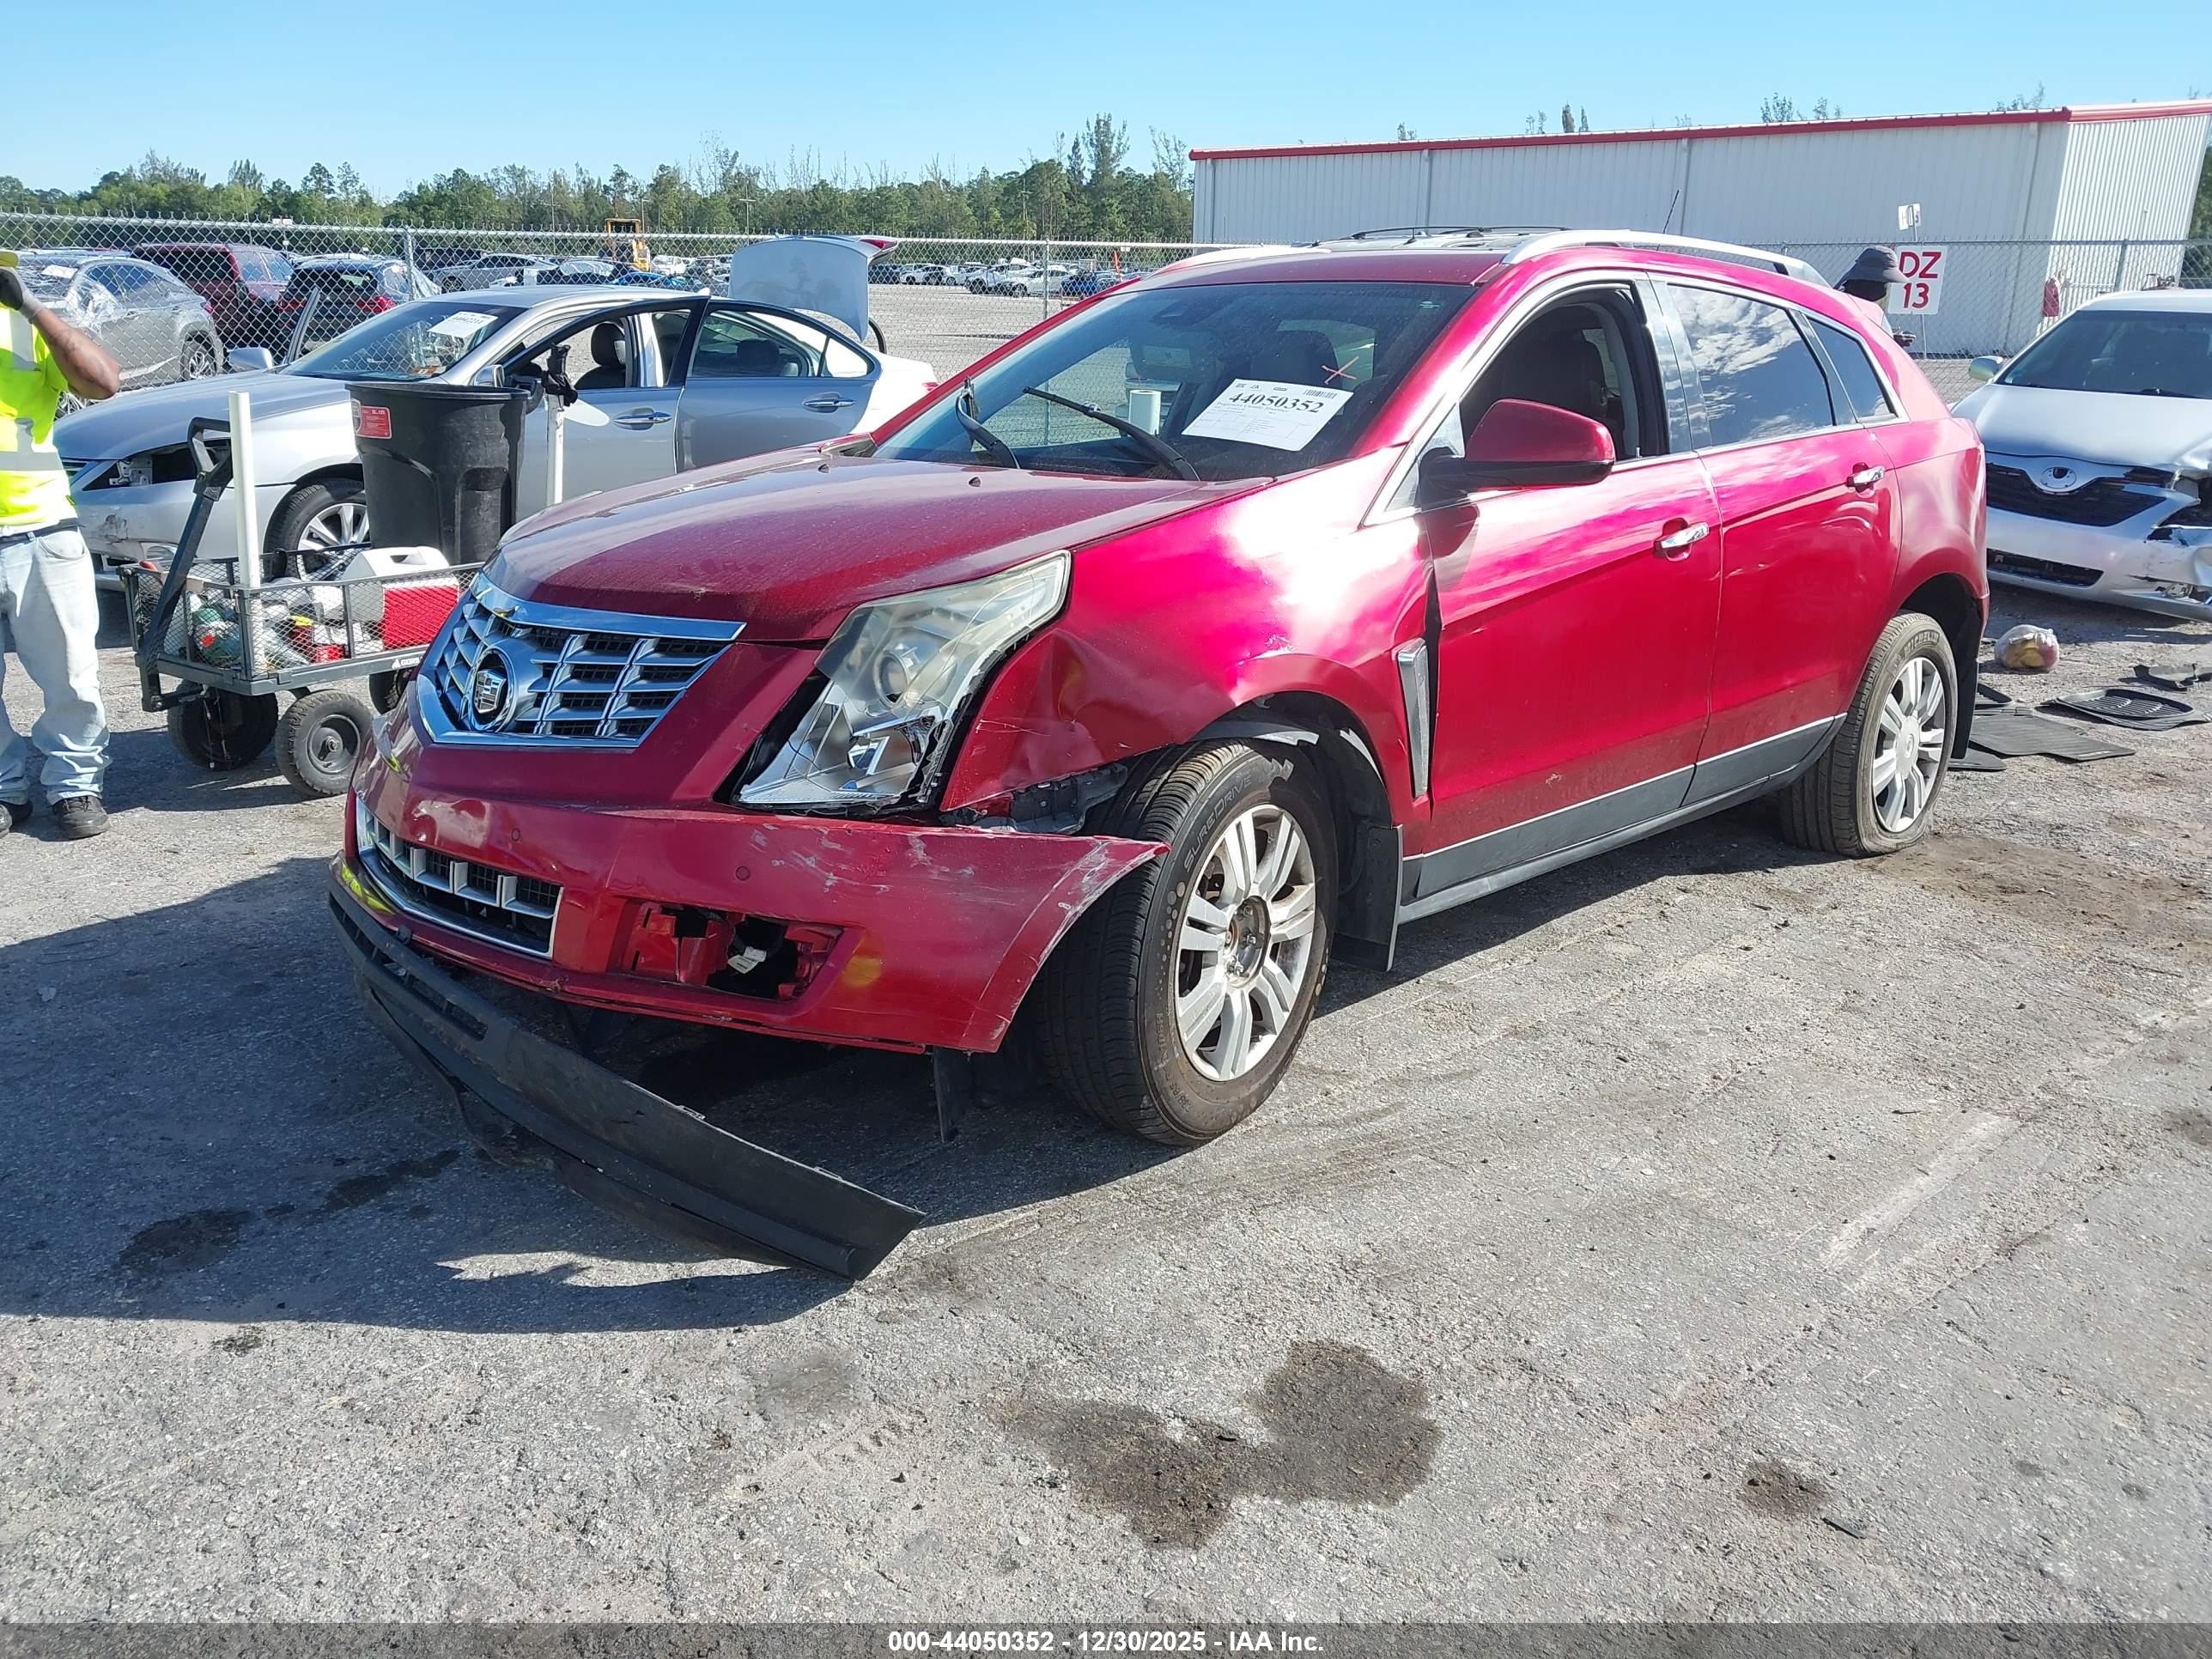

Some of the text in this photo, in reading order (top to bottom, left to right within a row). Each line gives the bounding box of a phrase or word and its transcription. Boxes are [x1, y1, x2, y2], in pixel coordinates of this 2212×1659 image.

[1899, 251, 1942, 278] DZ
[1903, 283, 1929, 308] 13
[1229, 392, 1325, 414] 44050352
